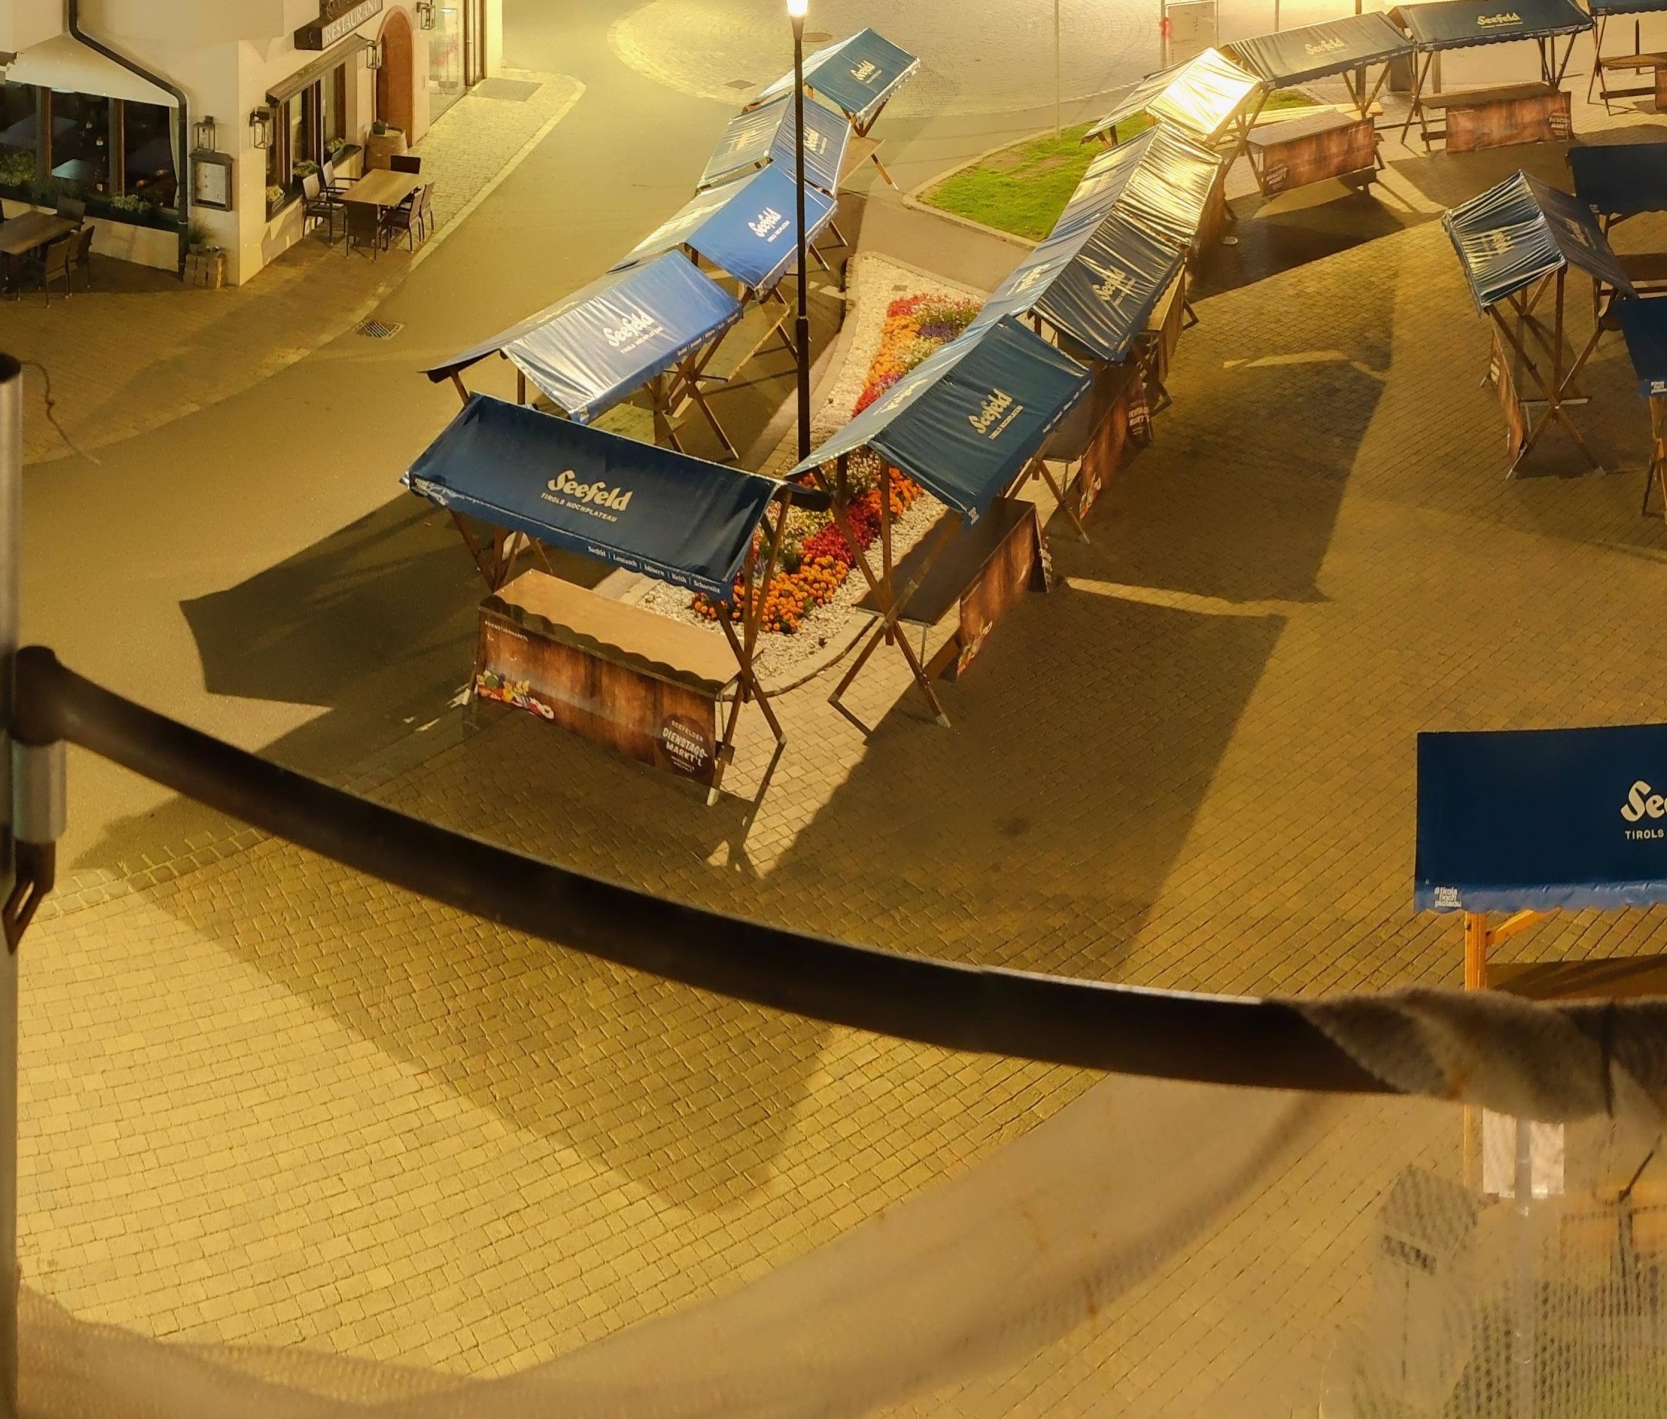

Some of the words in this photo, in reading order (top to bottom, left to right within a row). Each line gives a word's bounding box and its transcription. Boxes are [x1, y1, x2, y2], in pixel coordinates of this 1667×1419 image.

[1476, 12, 1521, 26] Seefeld
[1304, 37, 1345, 55] Seefeld
[748, 207, 783, 238] Seefeld
[603, 310, 655, 348] Seefeld
[968, 388, 1013, 434] Seefeld
[547, 469, 634, 512] Seefeld
[541, 492, 566, 507] TIROLS
[566, 501, 618, 523] HOCHPLATEAU
[1624, 829, 1665, 840] TIROLS
